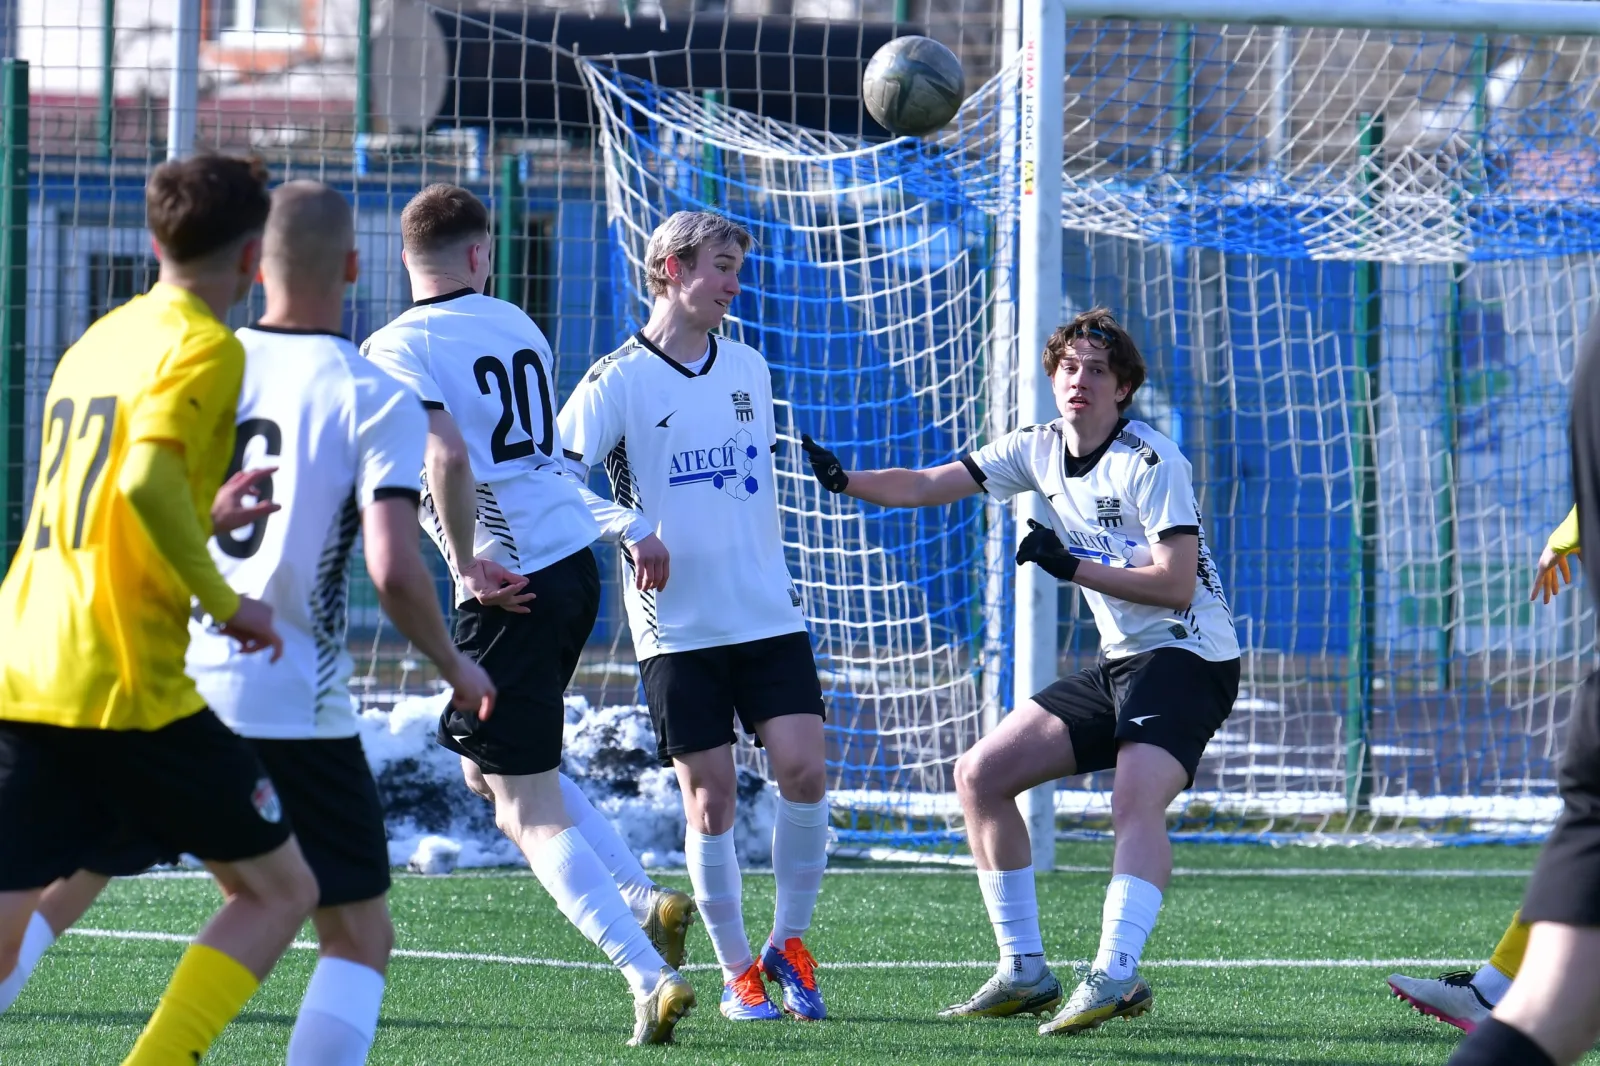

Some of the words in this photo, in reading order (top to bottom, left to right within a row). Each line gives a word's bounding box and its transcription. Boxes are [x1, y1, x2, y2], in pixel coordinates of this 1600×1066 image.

[34, 395, 118, 551] 27
[473, 349, 554, 465] 20
[215, 418, 282, 559] 6
